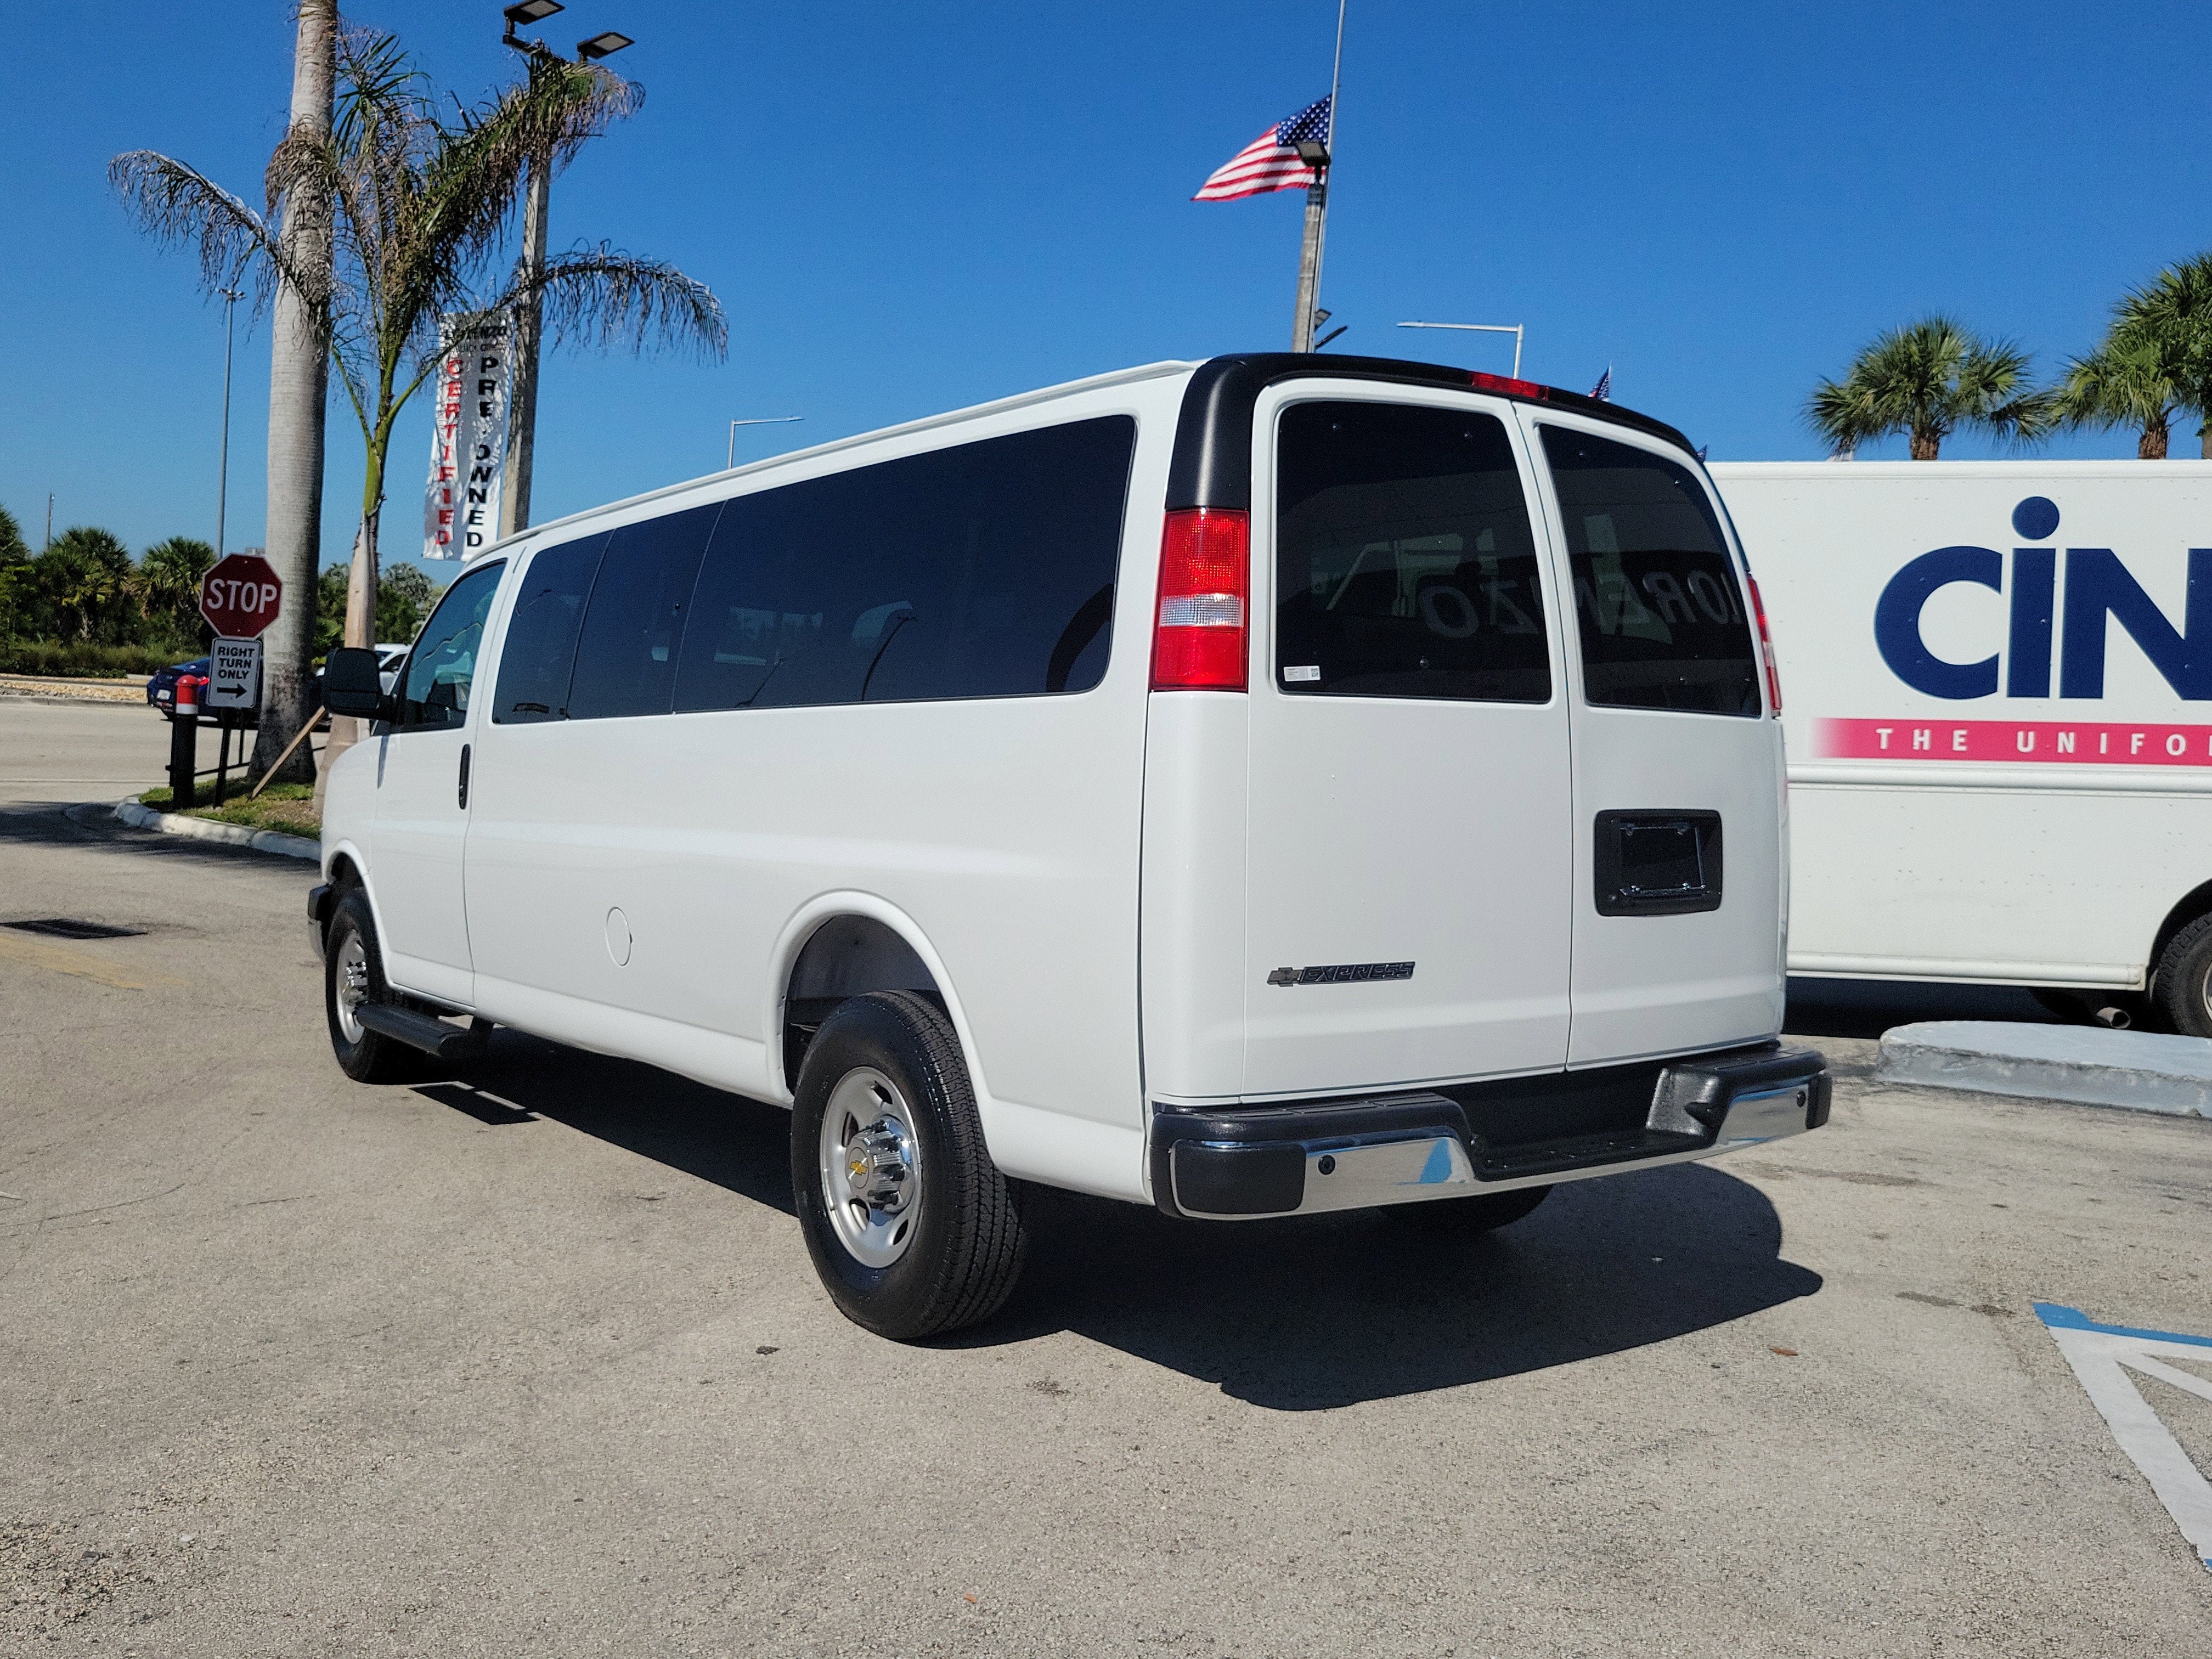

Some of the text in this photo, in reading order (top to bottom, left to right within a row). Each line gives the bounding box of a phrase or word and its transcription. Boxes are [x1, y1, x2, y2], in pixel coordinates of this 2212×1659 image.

[436, 358, 462, 545] CERTIFIED
[206, 579, 277, 613] STOP
[217, 646, 255, 658] RIGHT
[220, 658, 252, 669] TURN
[219, 669, 250, 680] ONLY
[1876, 728, 2212, 757] THE UNIFO
[1300, 962, 1414, 983] EXPRESS
